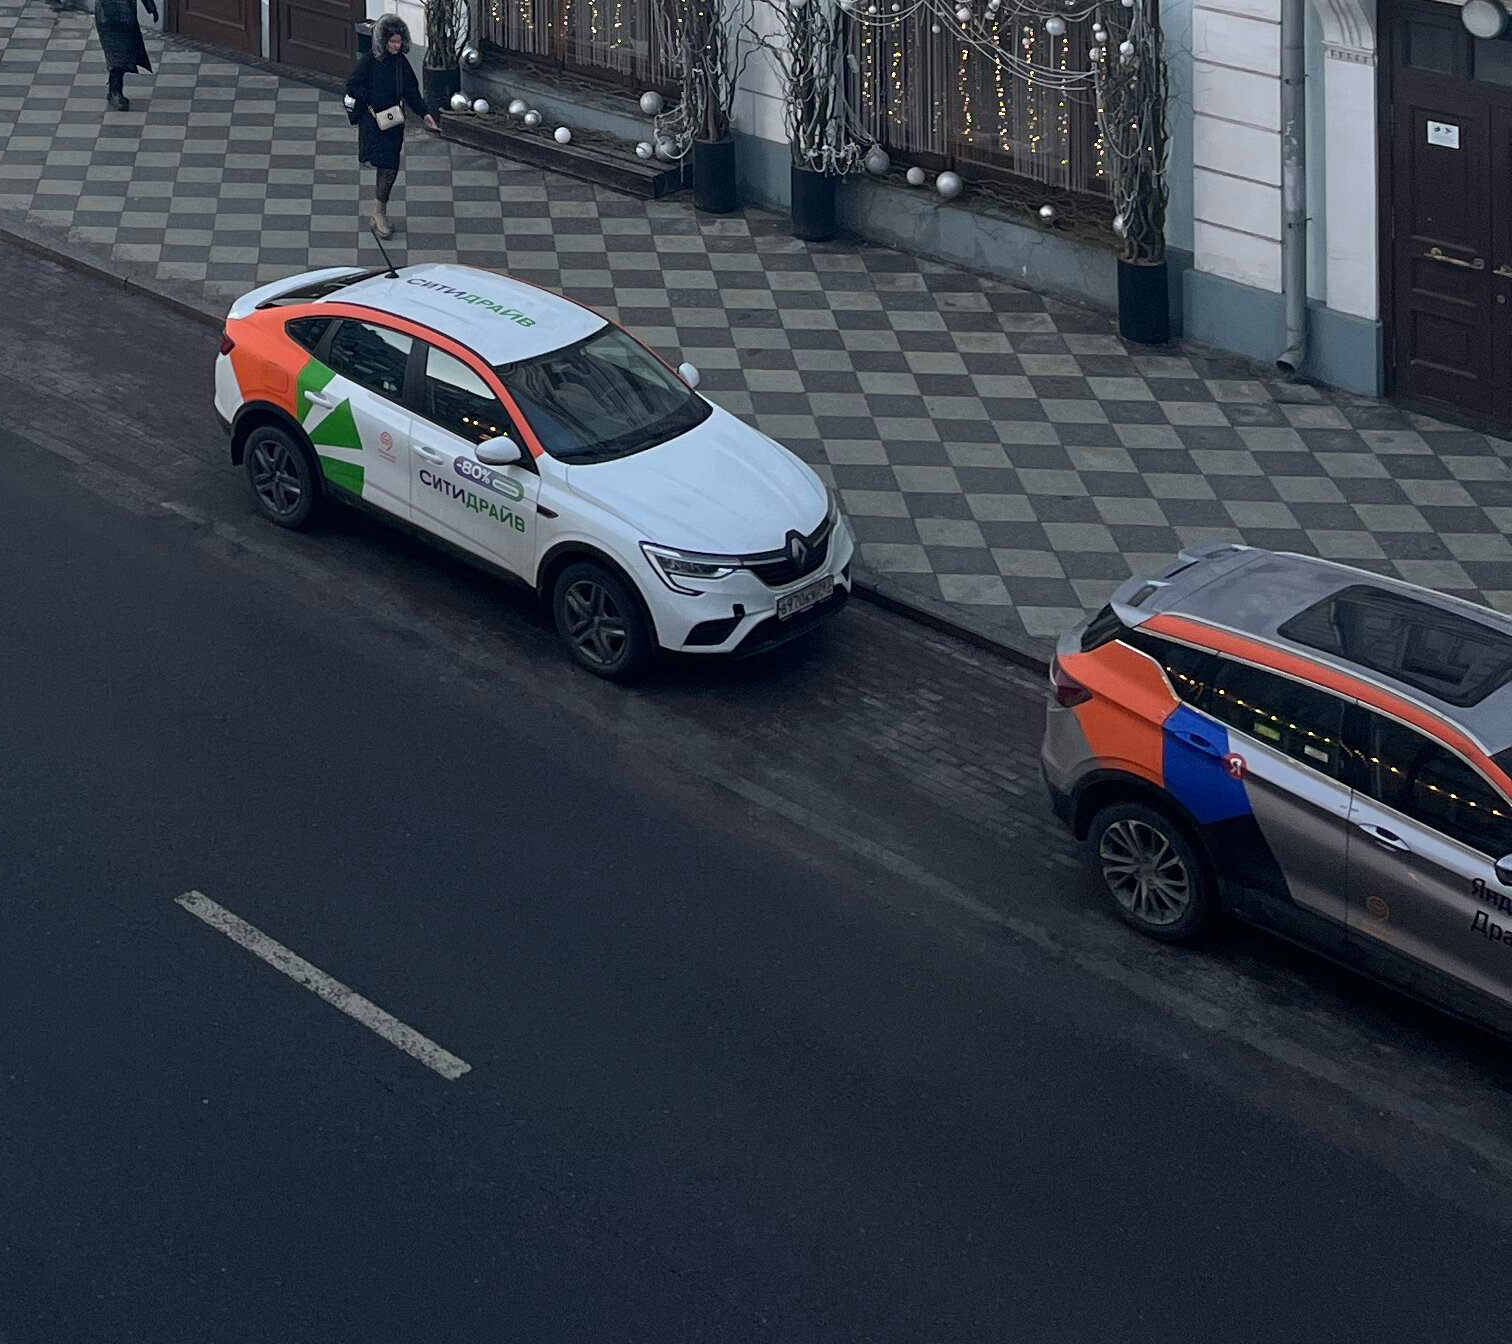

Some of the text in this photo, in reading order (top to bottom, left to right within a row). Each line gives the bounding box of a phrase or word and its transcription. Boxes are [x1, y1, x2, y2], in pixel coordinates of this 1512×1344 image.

[406, 278, 536, 328] СИТИДРАЙВ
[455, 460, 491, 485] -80%
[419, 469, 526, 533] СИТИДРАЙВ
